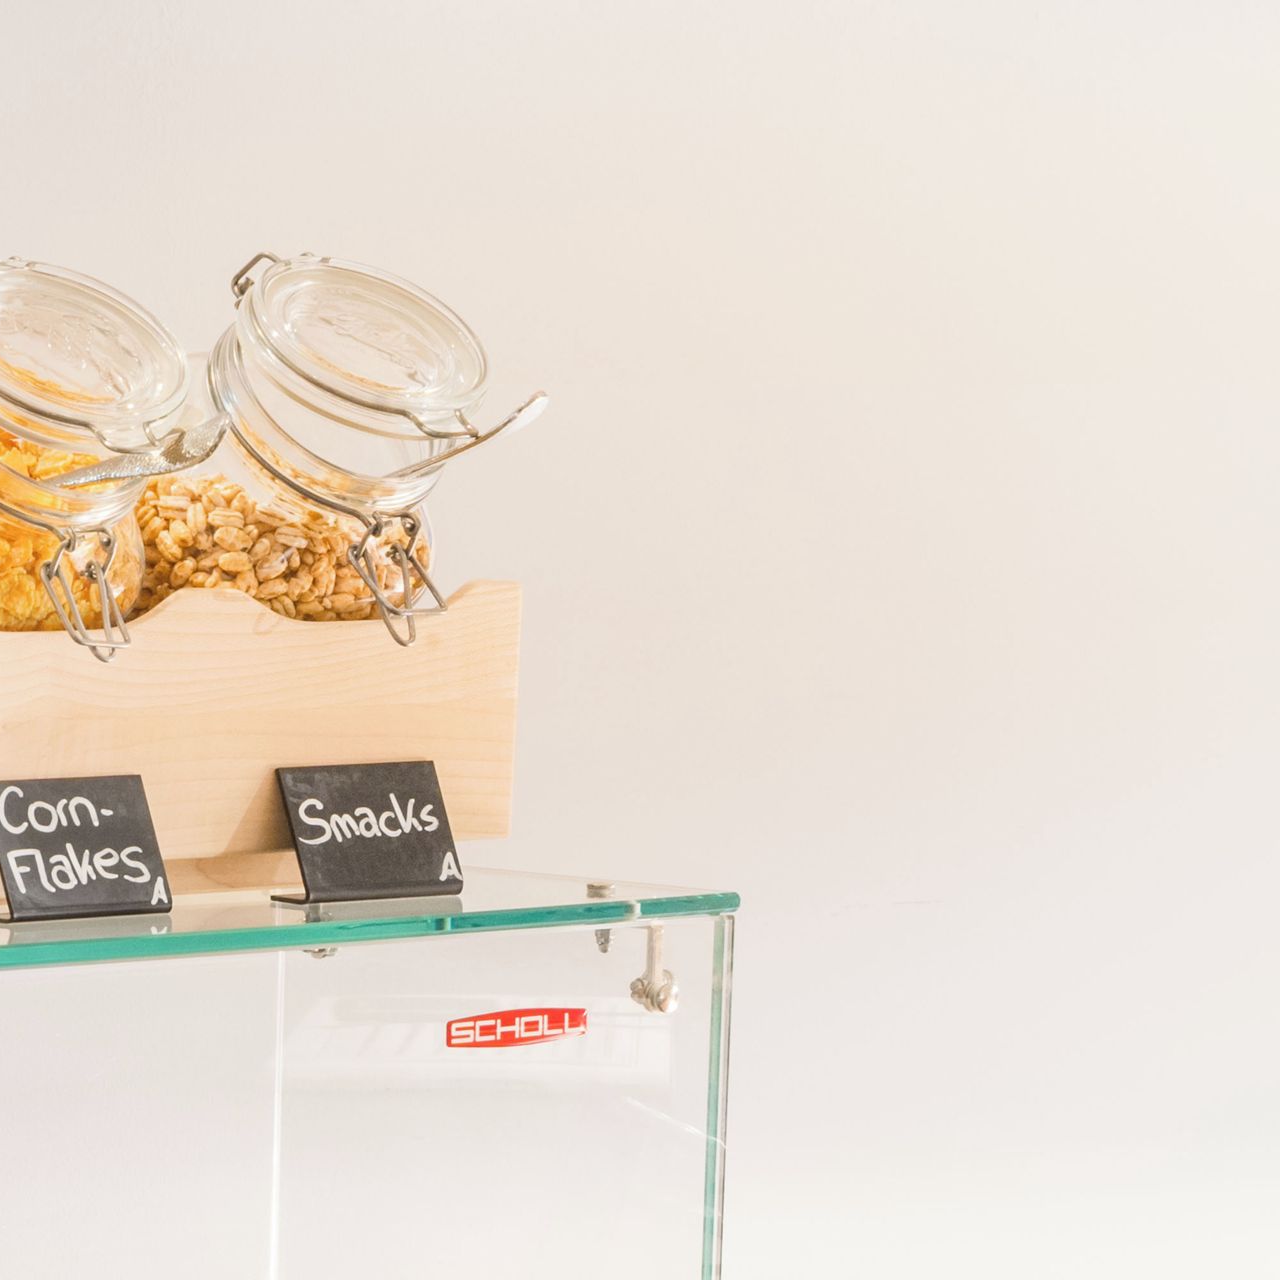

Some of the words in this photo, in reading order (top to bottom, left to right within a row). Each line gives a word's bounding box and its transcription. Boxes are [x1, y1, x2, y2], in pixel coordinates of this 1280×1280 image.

[298, 793, 439, 845] Smacks
[7, 843, 151, 894] Flakes
[440, 852, 463, 881] A
[151, 876, 168, 905] A
[451, 1013, 586, 1044] SCHOLL
